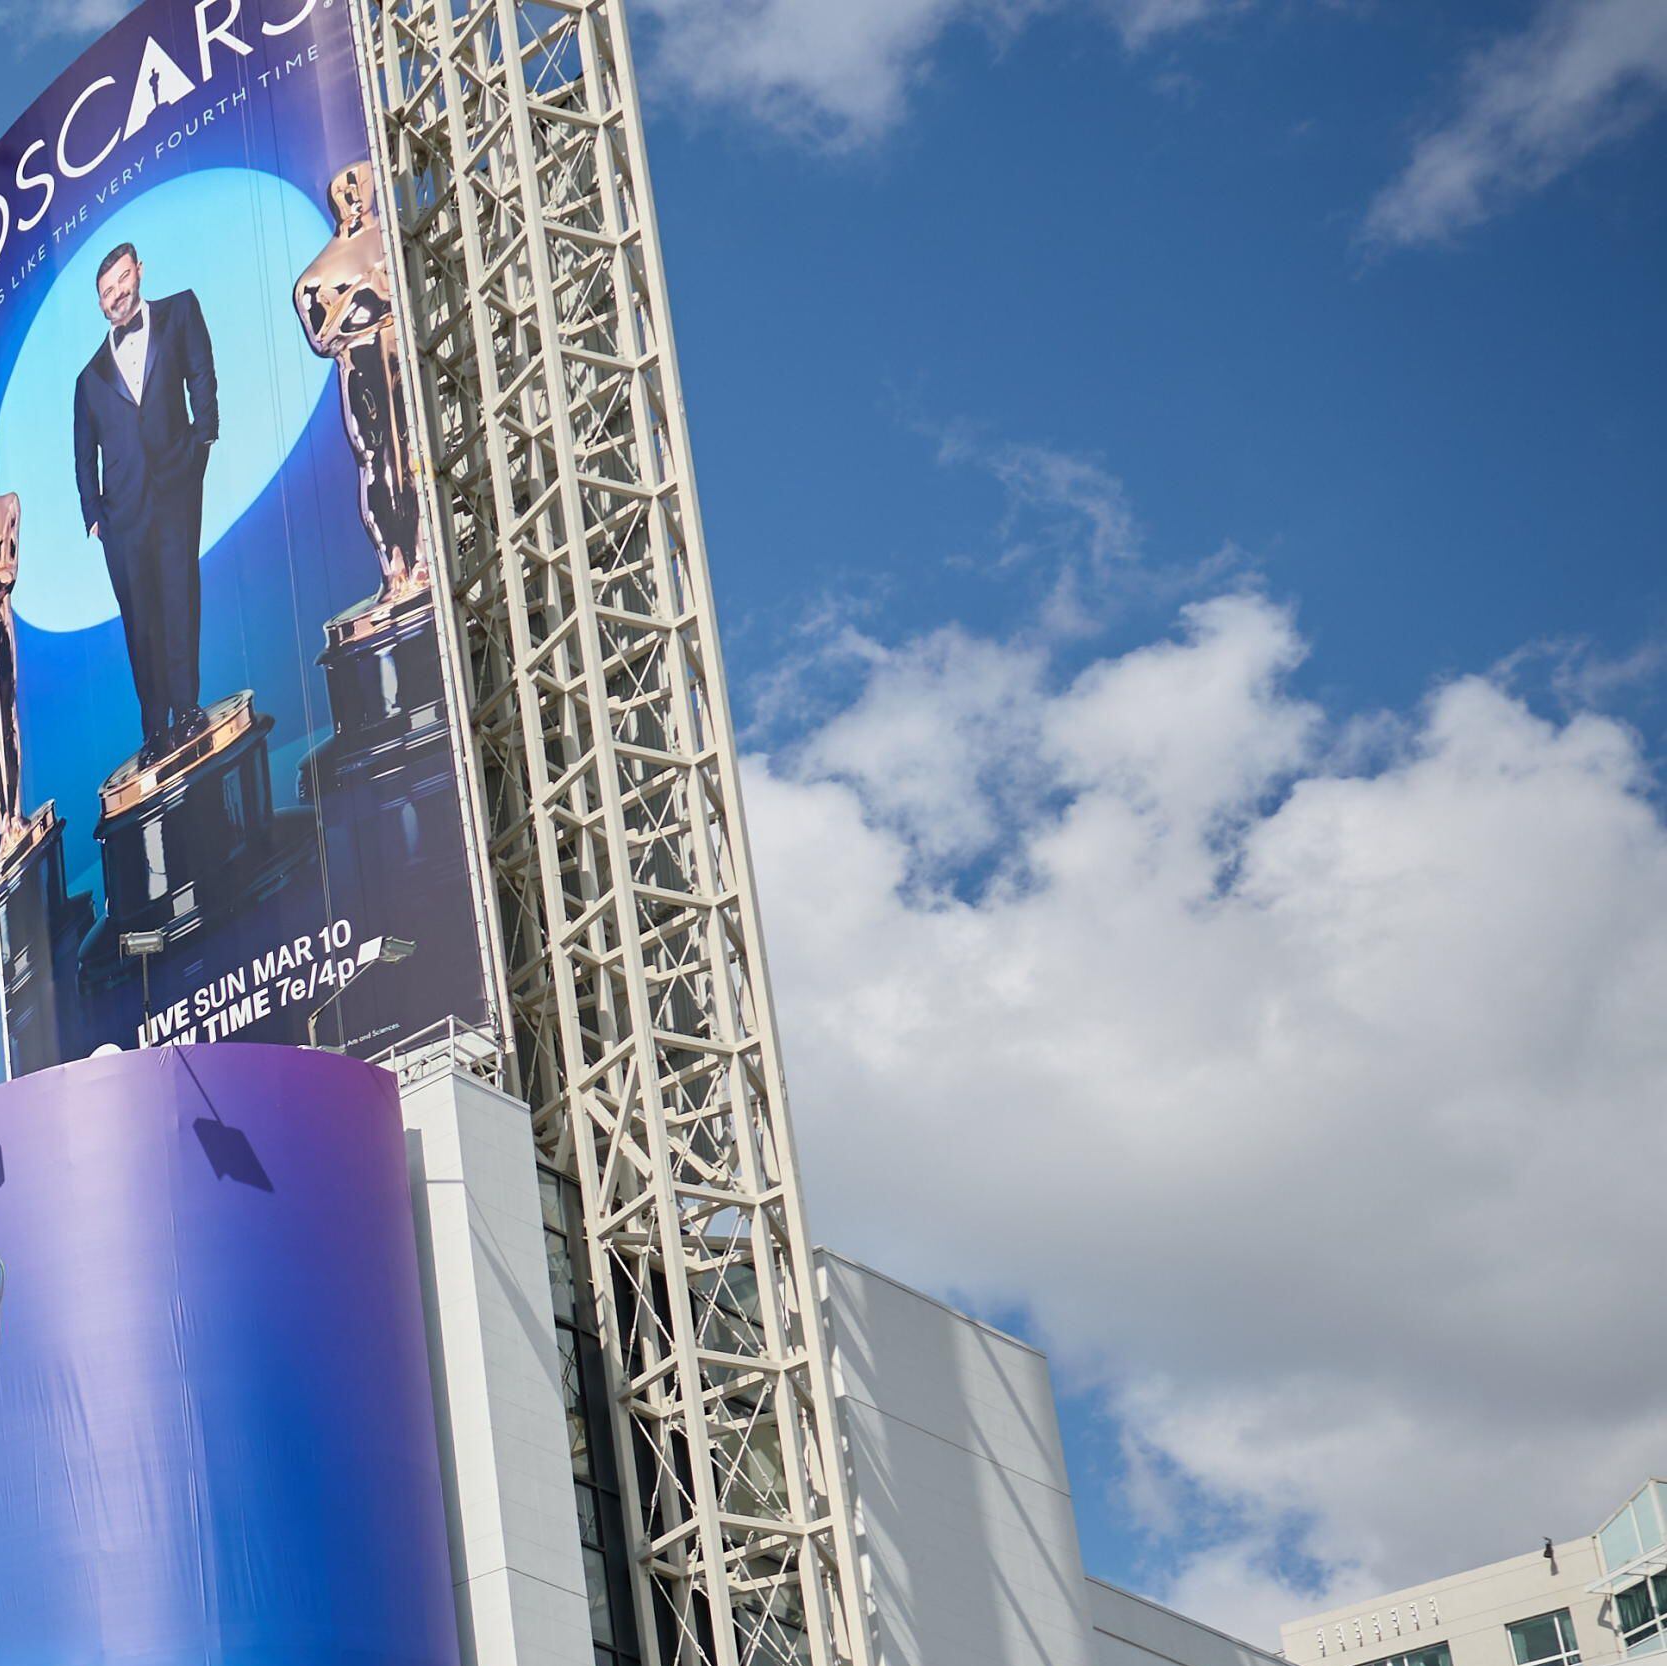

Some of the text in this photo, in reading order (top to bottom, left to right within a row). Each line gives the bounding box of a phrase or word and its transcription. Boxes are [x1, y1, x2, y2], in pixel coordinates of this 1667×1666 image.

[12, 245, 46, 289] LIKE
[53, 207, 88, 243] THE
[95, 158, 145, 204] VERY
[155, 87, 247, 159] FOURTH
[258, 43, 320, 88] TIME
[137, 998, 190, 1049] LIVE
[194, 967, 246, 1017] SUN
[252, 935, 316, 987] MAR
[318, 919, 352, 954] 10
[202, 956, 355, 1043] TIME 7e/4p
